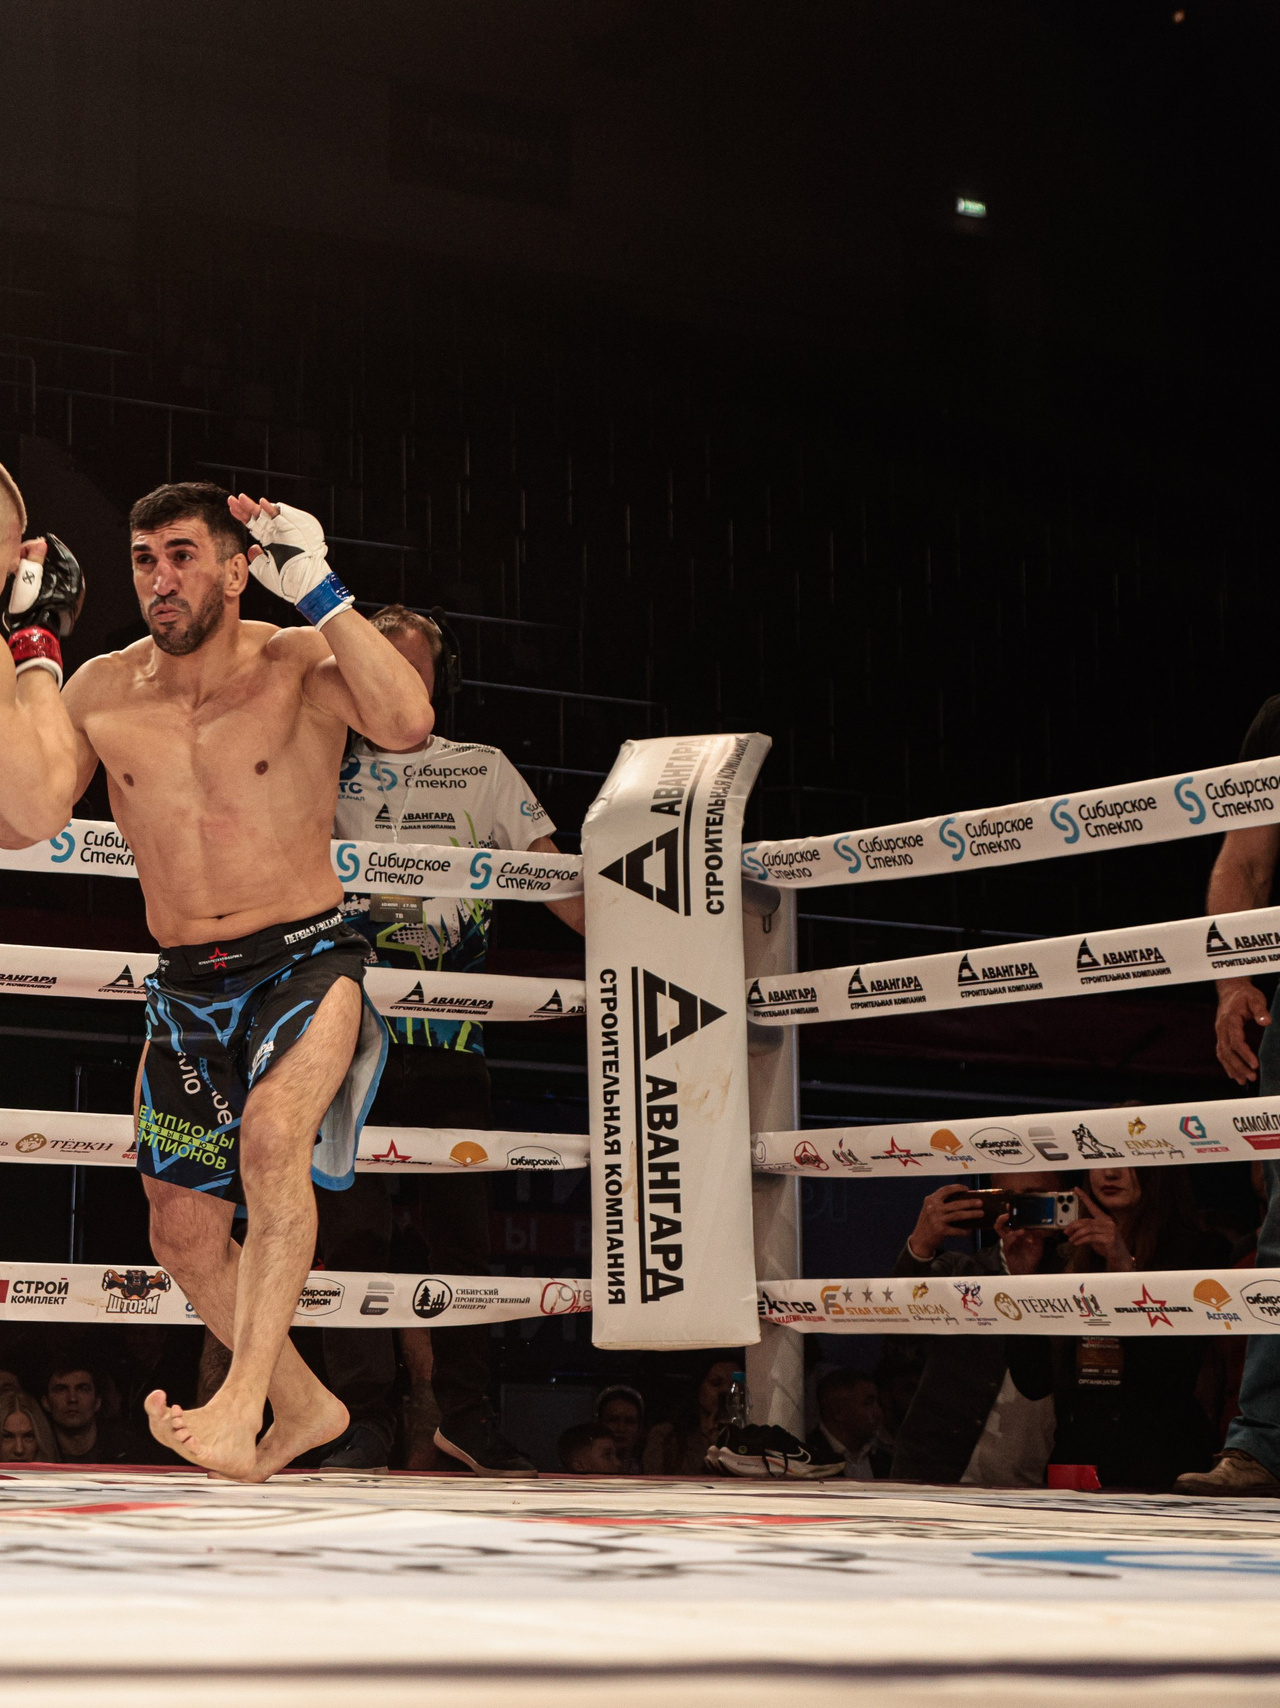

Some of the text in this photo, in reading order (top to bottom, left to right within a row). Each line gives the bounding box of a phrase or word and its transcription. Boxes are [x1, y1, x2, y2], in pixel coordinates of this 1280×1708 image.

[338, 781, 363, 795] ТС
[1205, 775, 1280, 800] Сибирско
[1078, 795, 1157, 821] Сибирское
[1212, 795, 1274, 819] Стекло
[965, 815, 1033, 839] Сибирское
[1084, 818, 1143, 839] Стекло
[704, 777, 733, 915] СТРОИТЕЛЬНАЯ
[858, 832, 924, 854] Сибирское
[970, 837, 1021, 857] Стекло
[80, 847, 134, 866] Стекл
[369, 852, 451, 872] Сибирское
[761, 849, 821, 868] Сибирское
[865, 853, 914, 870] Стекло
[364, 868, 423, 885] Стекло
[500, 862, 578, 881] Сибирское
[496, 874, 551, 891] Стекло
[1234, 931, 1280, 950] АВАНГА
[1103, 947, 1167, 966] АВАНГАРД
[1211, 956, 1266, 970] СТРОИТЕЛЬНАЯ
[981, 962, 1040, 980] АВАНГАРД
[1080, 967, 1172, 985] СТРОИТЕЛЬНАЯ КОМПАНИЯ
[869, 975, 924, 993] АВАНГАРД
[960, 983, 1043, 999] СТРОИТЕЛЬНАЯ КОМПАНИЯ
[768, 987, 818, 1002] АВАНГАРД
[850, 995, 927, 1010] СТРОИТЕЛЬНАЯ КОМПАНИЯ
[138, 1104, 235, 1149] ЕМПИОНЫ
[50, 1138, 113, 1151] ТЁРКИ
[599, 968, 627, 1305] СТРОИТЕЛЬНАЯ КОМПАНИЯ
[137, 1130, 228, 1170] МПИОНОВ
[644, 1074, 685, 1304] АВАНГАРД
[13, 1277, 69, 1296] СТРОЙ
[456, 1288, 499, 1296] СИБИРСКИЙ
[11, 1296, 67, 1305] КОМПЛЕКТ
[106, 1293, 161, 1314] ШТОРМ
[454, 1296, 531, 1304] ПРОИЗВОДСТВЕННЫЙ
[1018, 1296, 1074, 1313] ТЁРКИ
[845, 1307, 902, 1315] STAR FIGHT
[1206, 1311, 1241, 1321] Асгард
